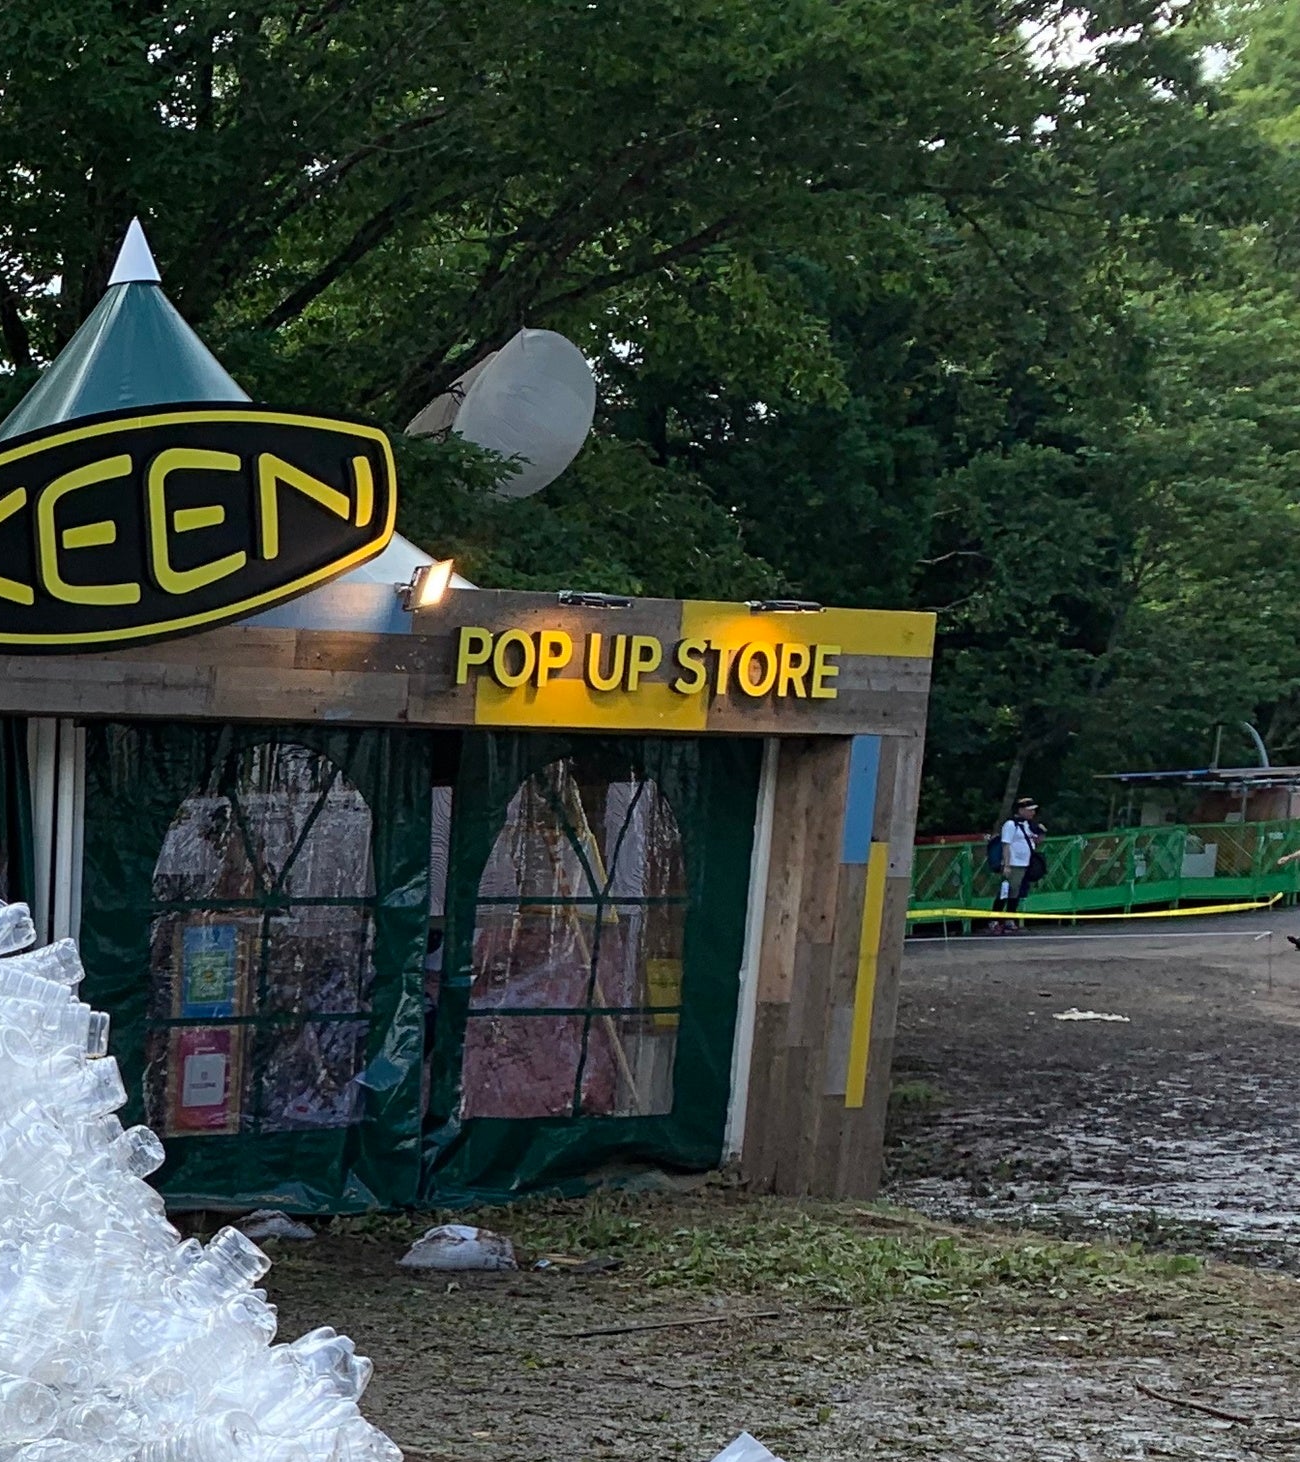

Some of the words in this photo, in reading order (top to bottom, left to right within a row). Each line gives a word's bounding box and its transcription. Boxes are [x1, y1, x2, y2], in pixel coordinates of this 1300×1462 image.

[455, 625, 572, 689] POP
[587, 633, 662, 692] UP
[673, 637, 842, 700] STORE
